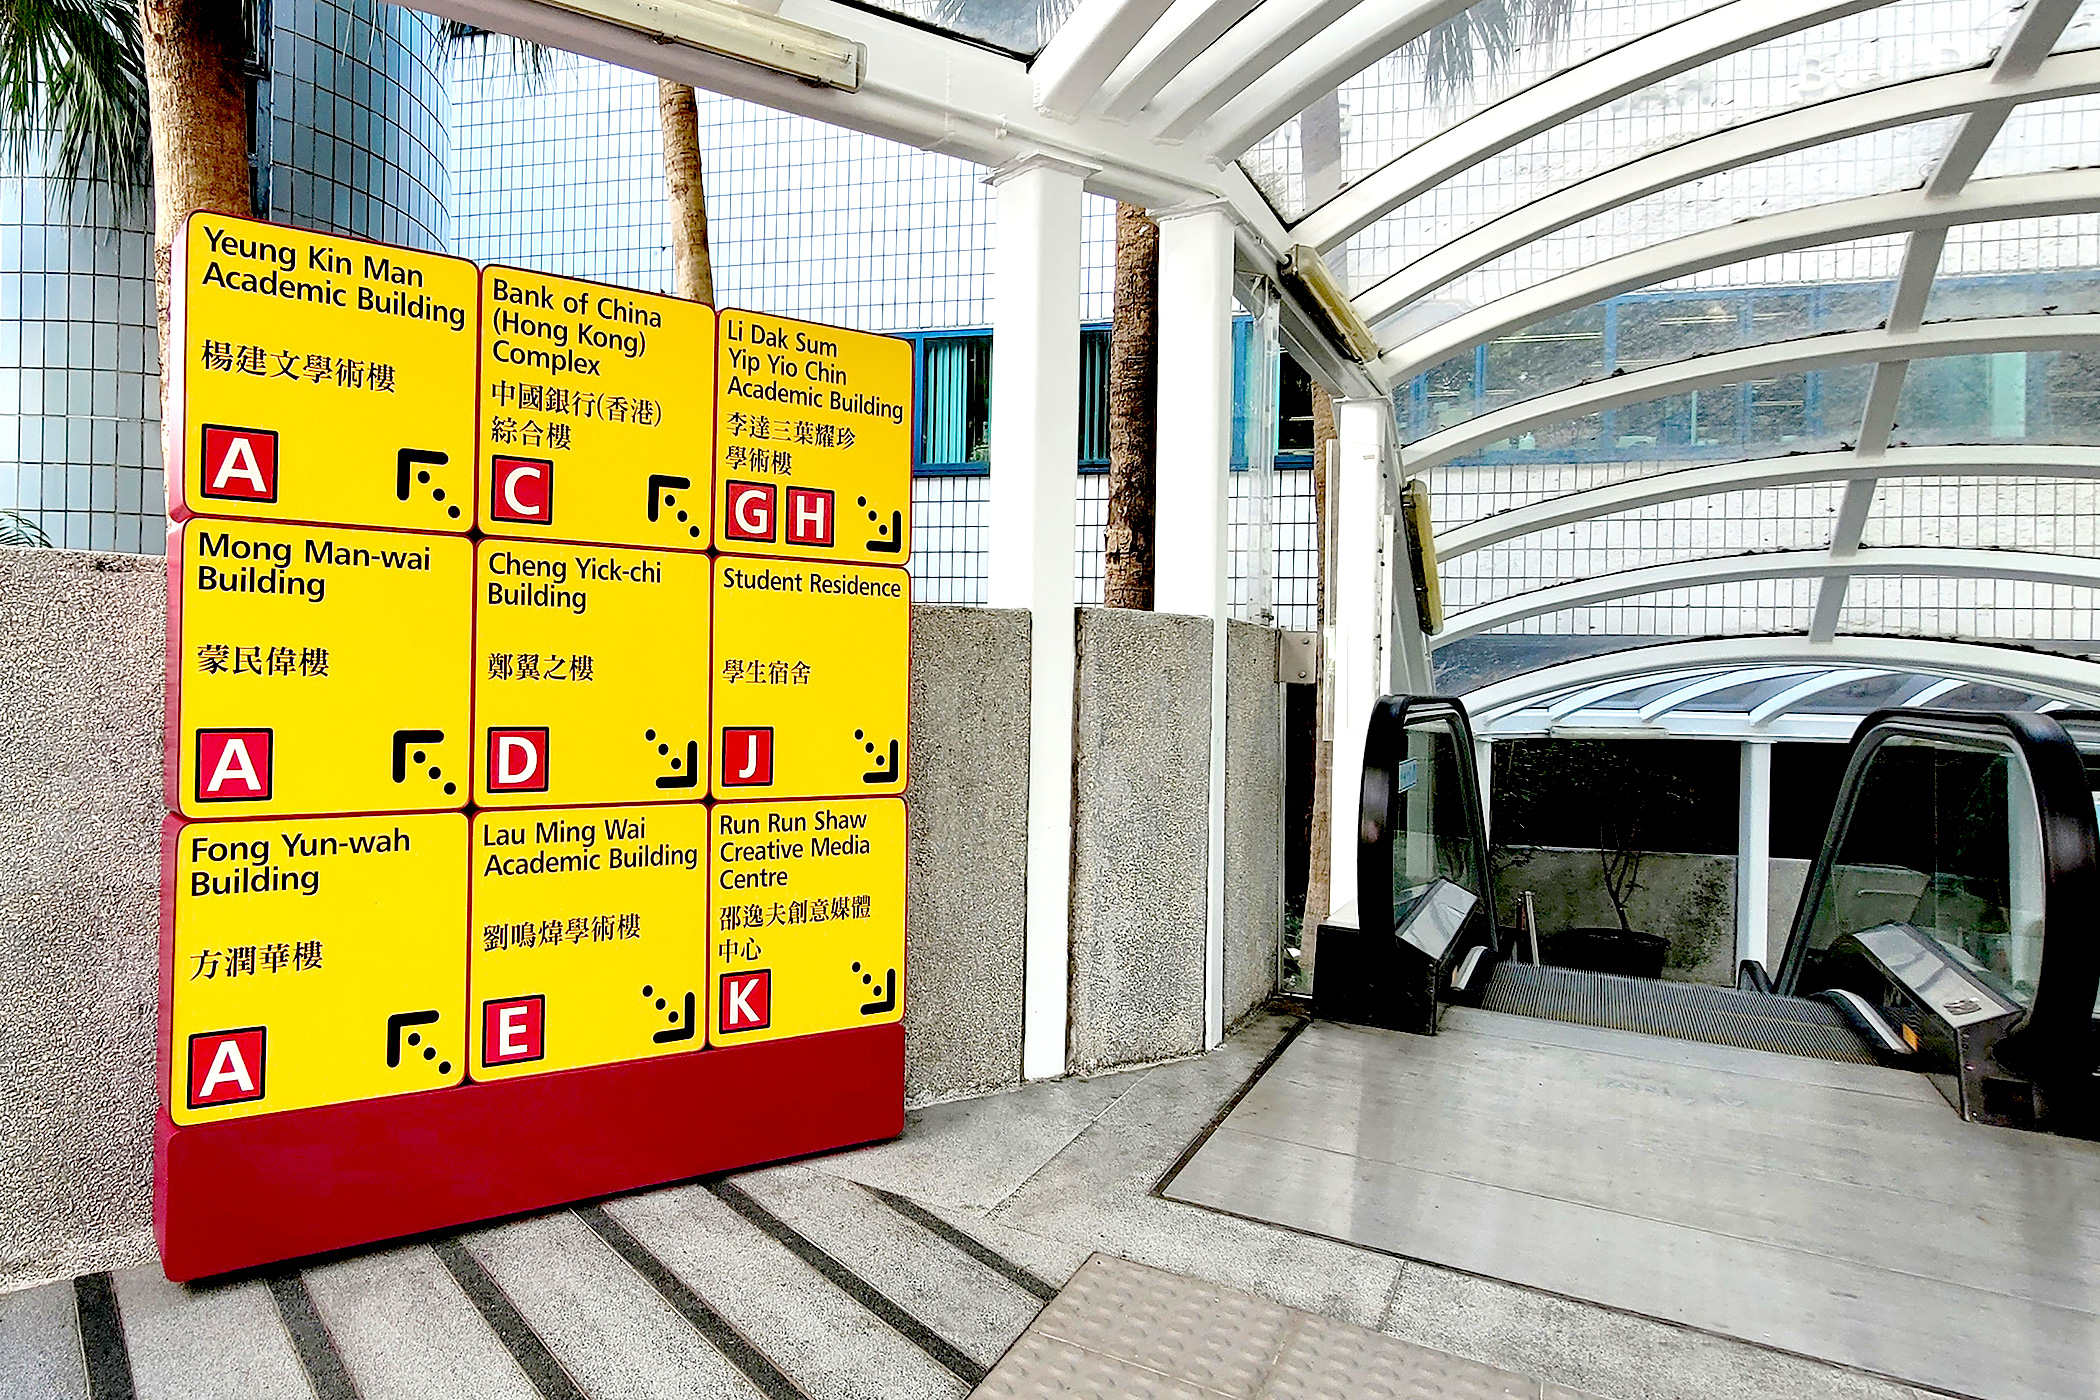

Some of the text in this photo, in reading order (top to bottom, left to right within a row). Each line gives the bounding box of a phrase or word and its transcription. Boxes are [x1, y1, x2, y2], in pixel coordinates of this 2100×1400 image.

[204, 227, 422, 287] Yeung Kin Man
[203, 262, 464, 331] Academic Building
[494, 278, 660, 327] Bank of China
[494, 308, 645, 357] (Hong Kong)
[729, 320, 836, 357] Li Dak Sum
[202, 340, 394, 392] 楊建文學術樓
[493, 340, 599, 375] Complex
[729, 348, 846, 385] Yip Yio Chin
[493, 380, 660, 427] 中國銀行(香港)
[728, 376, 902, 424] Academic Building
[492, 416, 570, 450] 綜合樓
[726, 412, 855, 450] 李達三葉耀珍
[213, 438, 266, 492] A
[726, 447, 791, 475] 學術樓
[505, 467, 540, 514] C
[736, 490, 824, 538] G H
[200, 532, 429, 570] Mong Man-wai
[490, 552, 660, 587] Cheng Yick-chi
[199, 566, 324, 602] Building
[489, 583, 585, 614] Building
[724, 568, 900, 597] Student Residence
[198, 645, 328, 676] 蒙民偉樓
[490, 653, 593, 681] 鄭翼之樓
[723, 660, 810, 684] 學生宿舍
[207, 739, 261, 791] A
[499, 737, 537, 783] D
[739, 735, 756, 778] J
[485, 817, 644, 847] Lau Ming Wai
[721, 810, 866, 834] Run Run Shaw
[193, 828, 409, 866] Fong Yun-wah
[485, 844, 696, 876] Academic Building
[721, 835, 869, 862] Creative Media
[192, 866, 318, 896] Building
[720, 869, 787, 889] Centre
[720, 896, 870, 930] 邵逸夫創意媒體
[484, 914, 640, 951] 劉鳴煒學術樓
[720, 938, 761, 963] 中心
[190, 941, 322, 981] 方潤華樓
[730, 979, 760, 1024] K
[500, 1006, 527, 1056] E
[199, 1041, 254, 1097] A
